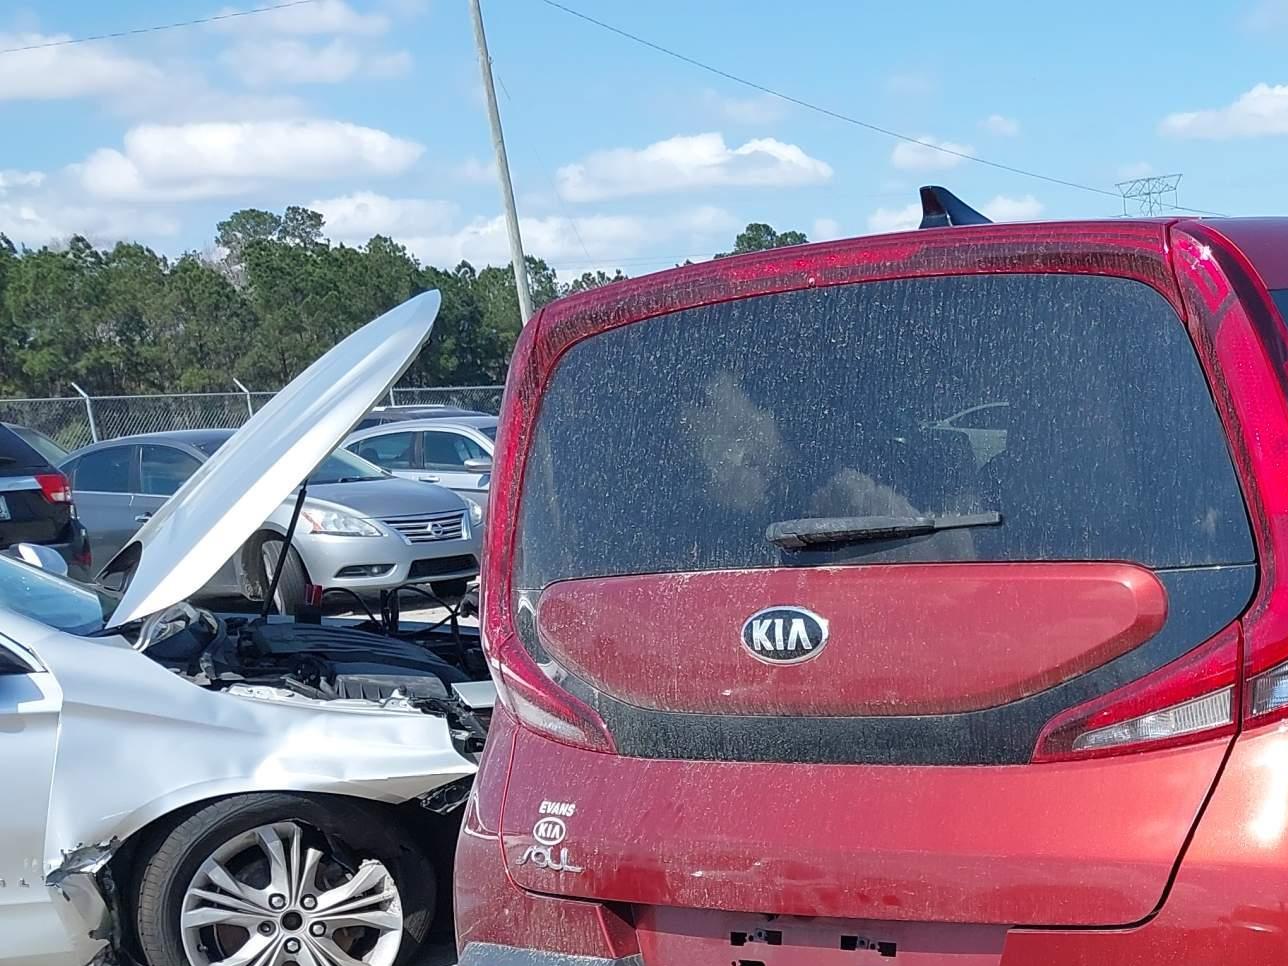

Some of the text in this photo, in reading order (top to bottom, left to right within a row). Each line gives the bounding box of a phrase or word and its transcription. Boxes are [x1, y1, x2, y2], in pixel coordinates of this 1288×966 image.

[752, 618, 813, 651] KIA
[538, 800, 576, 817] EVANS
[538, 823, 560, 840] KIA
